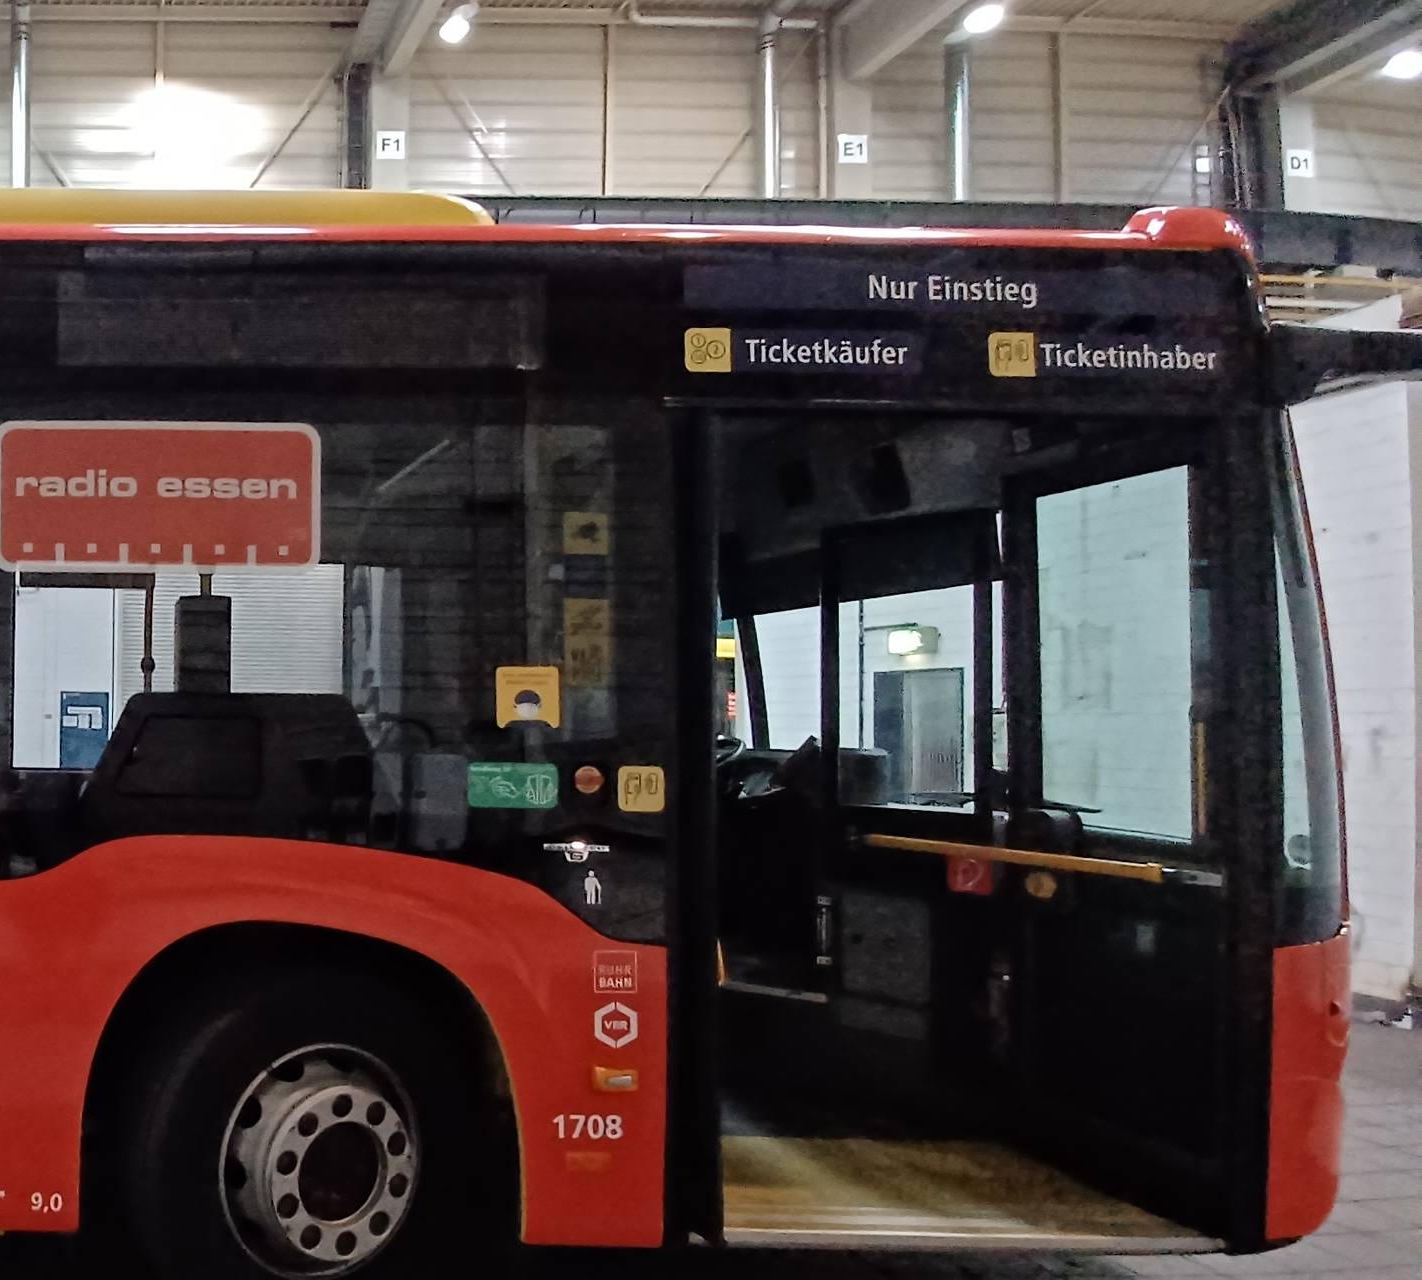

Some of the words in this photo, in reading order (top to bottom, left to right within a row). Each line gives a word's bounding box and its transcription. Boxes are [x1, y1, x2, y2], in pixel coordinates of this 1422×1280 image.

[382, 138, 400, 151] F1
[843, 142, 863, 156] E1
[1290, 156, 1308, 170] D1
[868, 275, 918, 300] Nur
[928, 275, 1038, 308] Einstieg
[745, 339, 908, 365] Ticketkäufer
[1039, 343, 1217, 370] Ticketinhaber
[15, 469, 138, 498] radio
[156, 476, 298, 500] essen
[598, 964, 632, 975] RUHR
[599, 977, 632, 988] BAHN
[552, 1114, 624, 1139] 1708
[30, 1192, 63, 1213] 9,0
